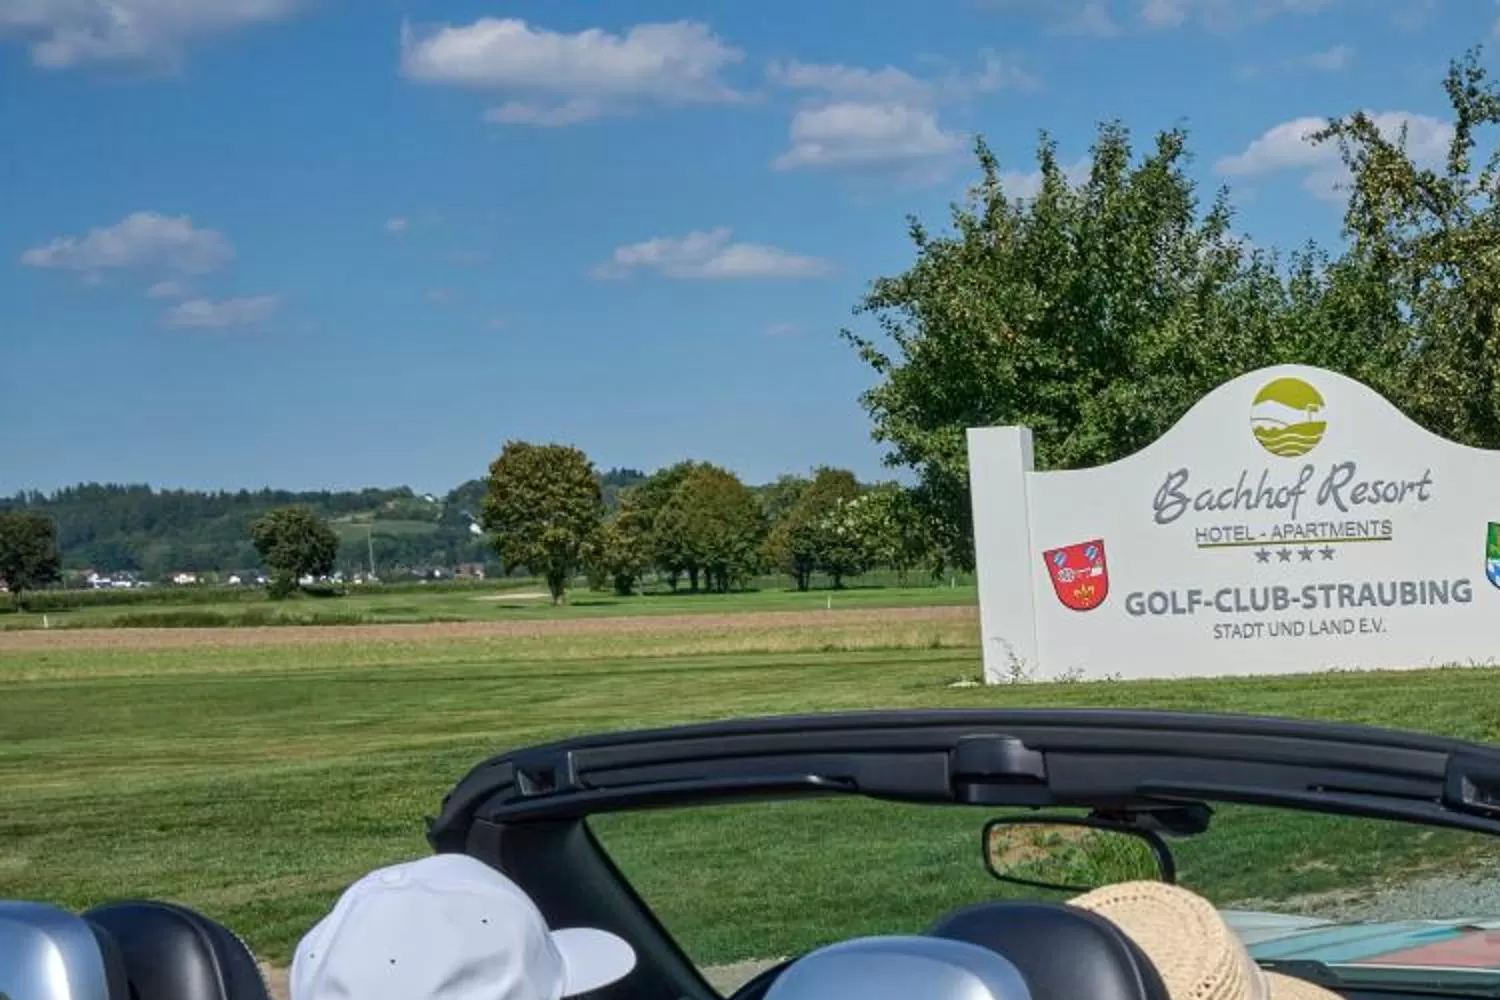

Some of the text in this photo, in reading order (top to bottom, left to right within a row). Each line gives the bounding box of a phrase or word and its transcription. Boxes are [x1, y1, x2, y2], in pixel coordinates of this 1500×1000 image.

[1152, 461, 1433, 525] Bachhof Resort
[1195, 525, 1257, 542] HOTEL
[1271, 519, 1393, 539] APARTMENTS
[1124, 578, 1474, 617] GOLF-CLUB-STRAUBING
[1212, 616, 1388, 640] STADT UND LAND E.V.
